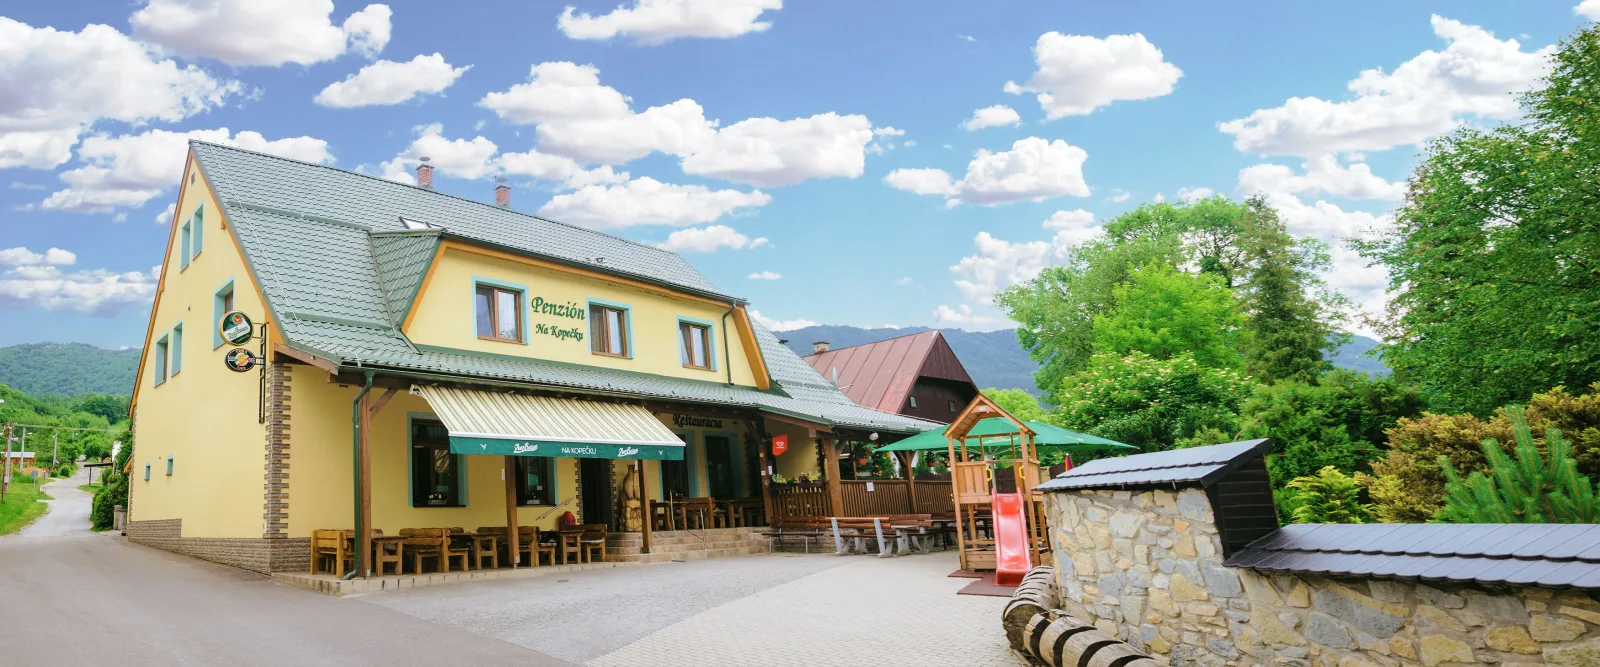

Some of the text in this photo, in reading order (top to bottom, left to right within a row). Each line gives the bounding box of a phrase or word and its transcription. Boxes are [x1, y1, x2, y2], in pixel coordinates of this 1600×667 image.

[531, 296, 585, 320] Penzión
[535, 323, 584, 342] Na Kopečku
[561, 445, 597, 455] NA KOPEČKU
